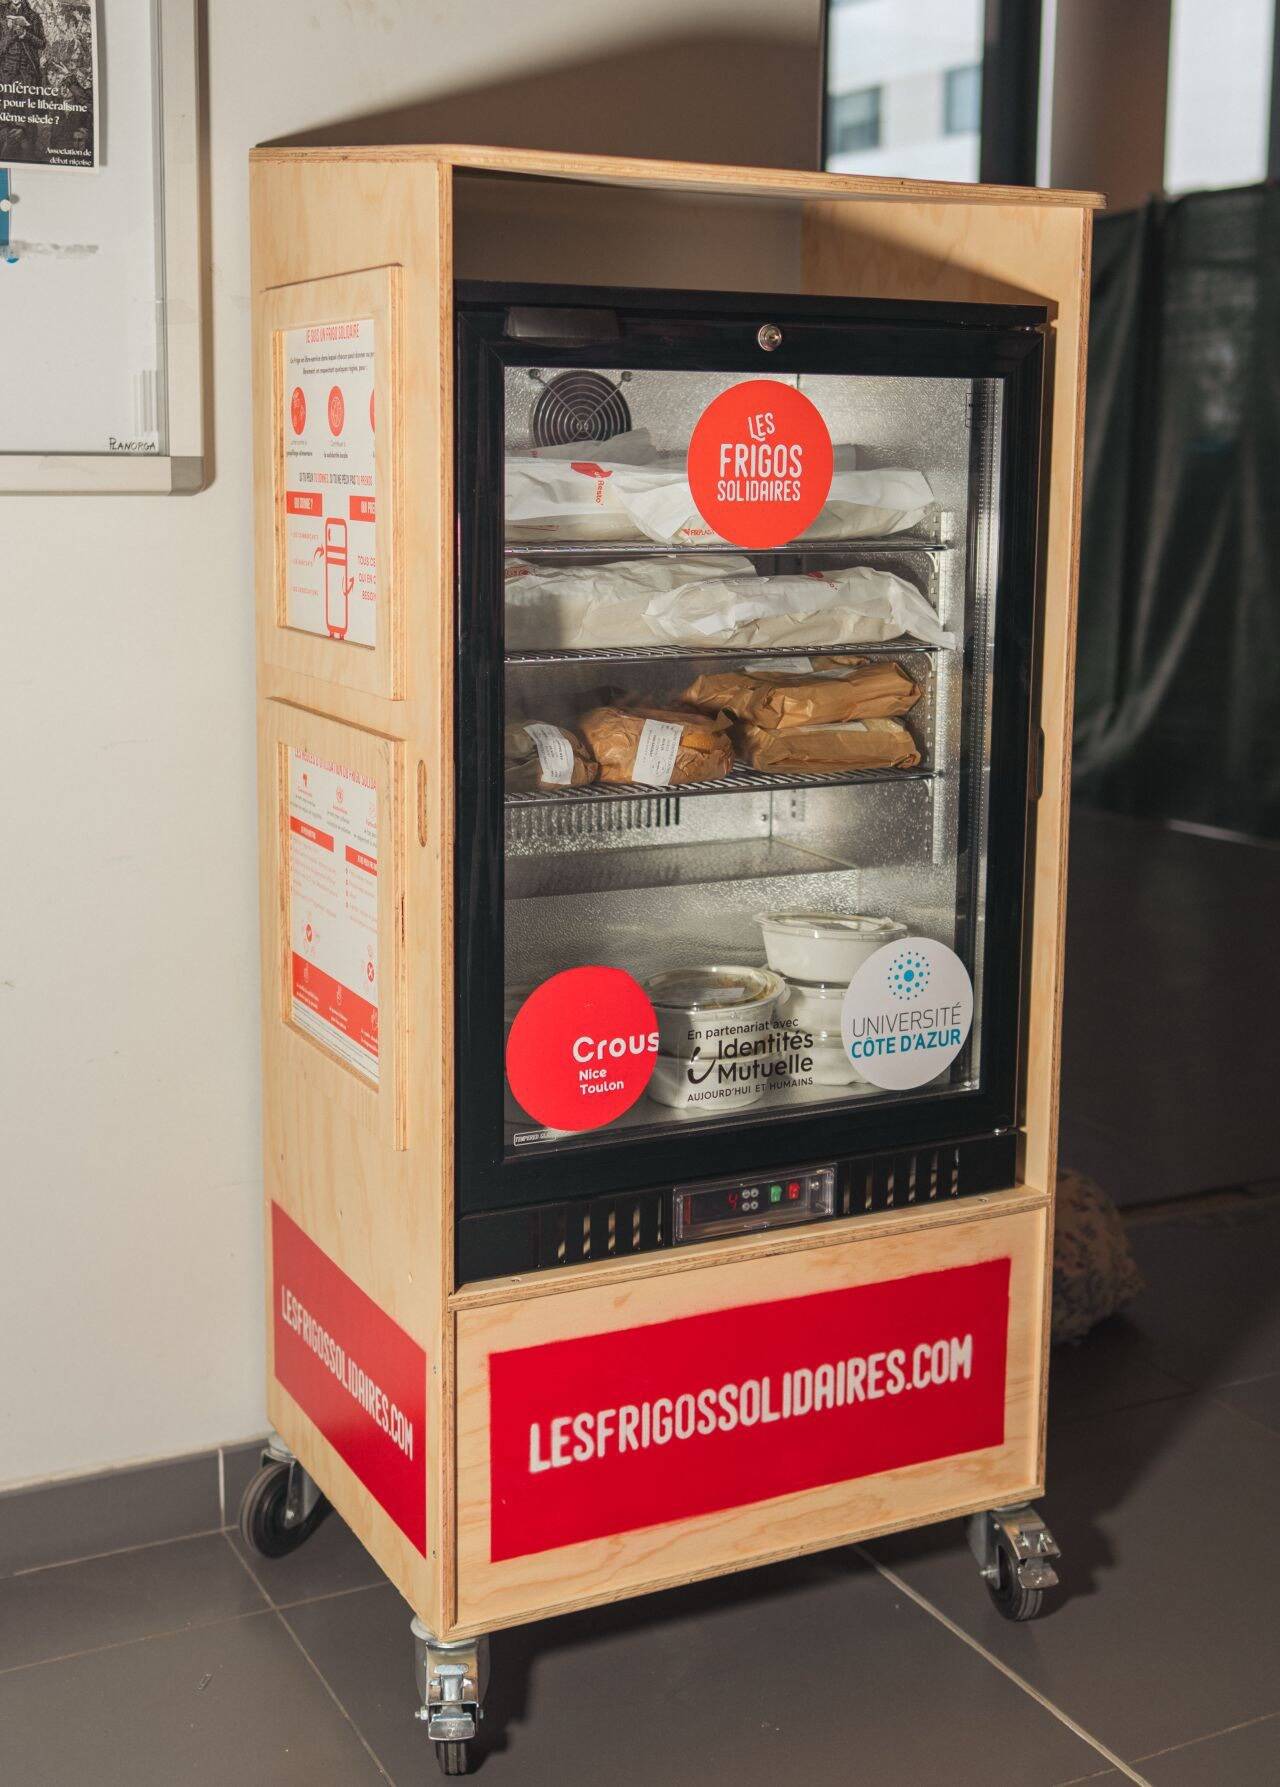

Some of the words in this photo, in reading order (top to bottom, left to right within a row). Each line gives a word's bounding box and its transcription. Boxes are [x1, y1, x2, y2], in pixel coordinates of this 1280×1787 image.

[3, 99, 26, 109] pour
[28, 98, 36, 109] le
[38, 99, 88, 112] libéralisme
[27, 114, 53, 124] siècle
[54, 116, 60, 125] ?
[747, 412, 776, 442] LES
[720, 443, 803, 478] FRIGOS
[717, 480, 801, 502] SOLIDAIRES
[687, 1029, 702, 1040] En
[705, 1021, 769, 1039] partenariat
[773, 1018, 799, 1029] avec
[853, 1002, 962, 1037] UNIVERSITÉ
[572, 1032, 660, 1063] Crous
[718, 1030, 814, 1060] Identités
[851, 1036, 896, 1059] CÔTE
[900, 1028, 961, 1053] D'AZUR
[579, 1068, 608, 1081] Nice
[718, 1054, 814, 1084] Mutuelle
[579, 1080, 625, 1096] Toulon
[687, 1085, 751, 1102] AUJOURD'HUI
[755, 1083, 766, 1093] ET
[769, 1076, 814, 1091] HUMAINS
[282, 1284, 414, 1462] LESFRIGOSSOLIDAIRES.COM
[528, 1333, 974, 1475] LESFRIGOSSOLIDAIRES.COM
